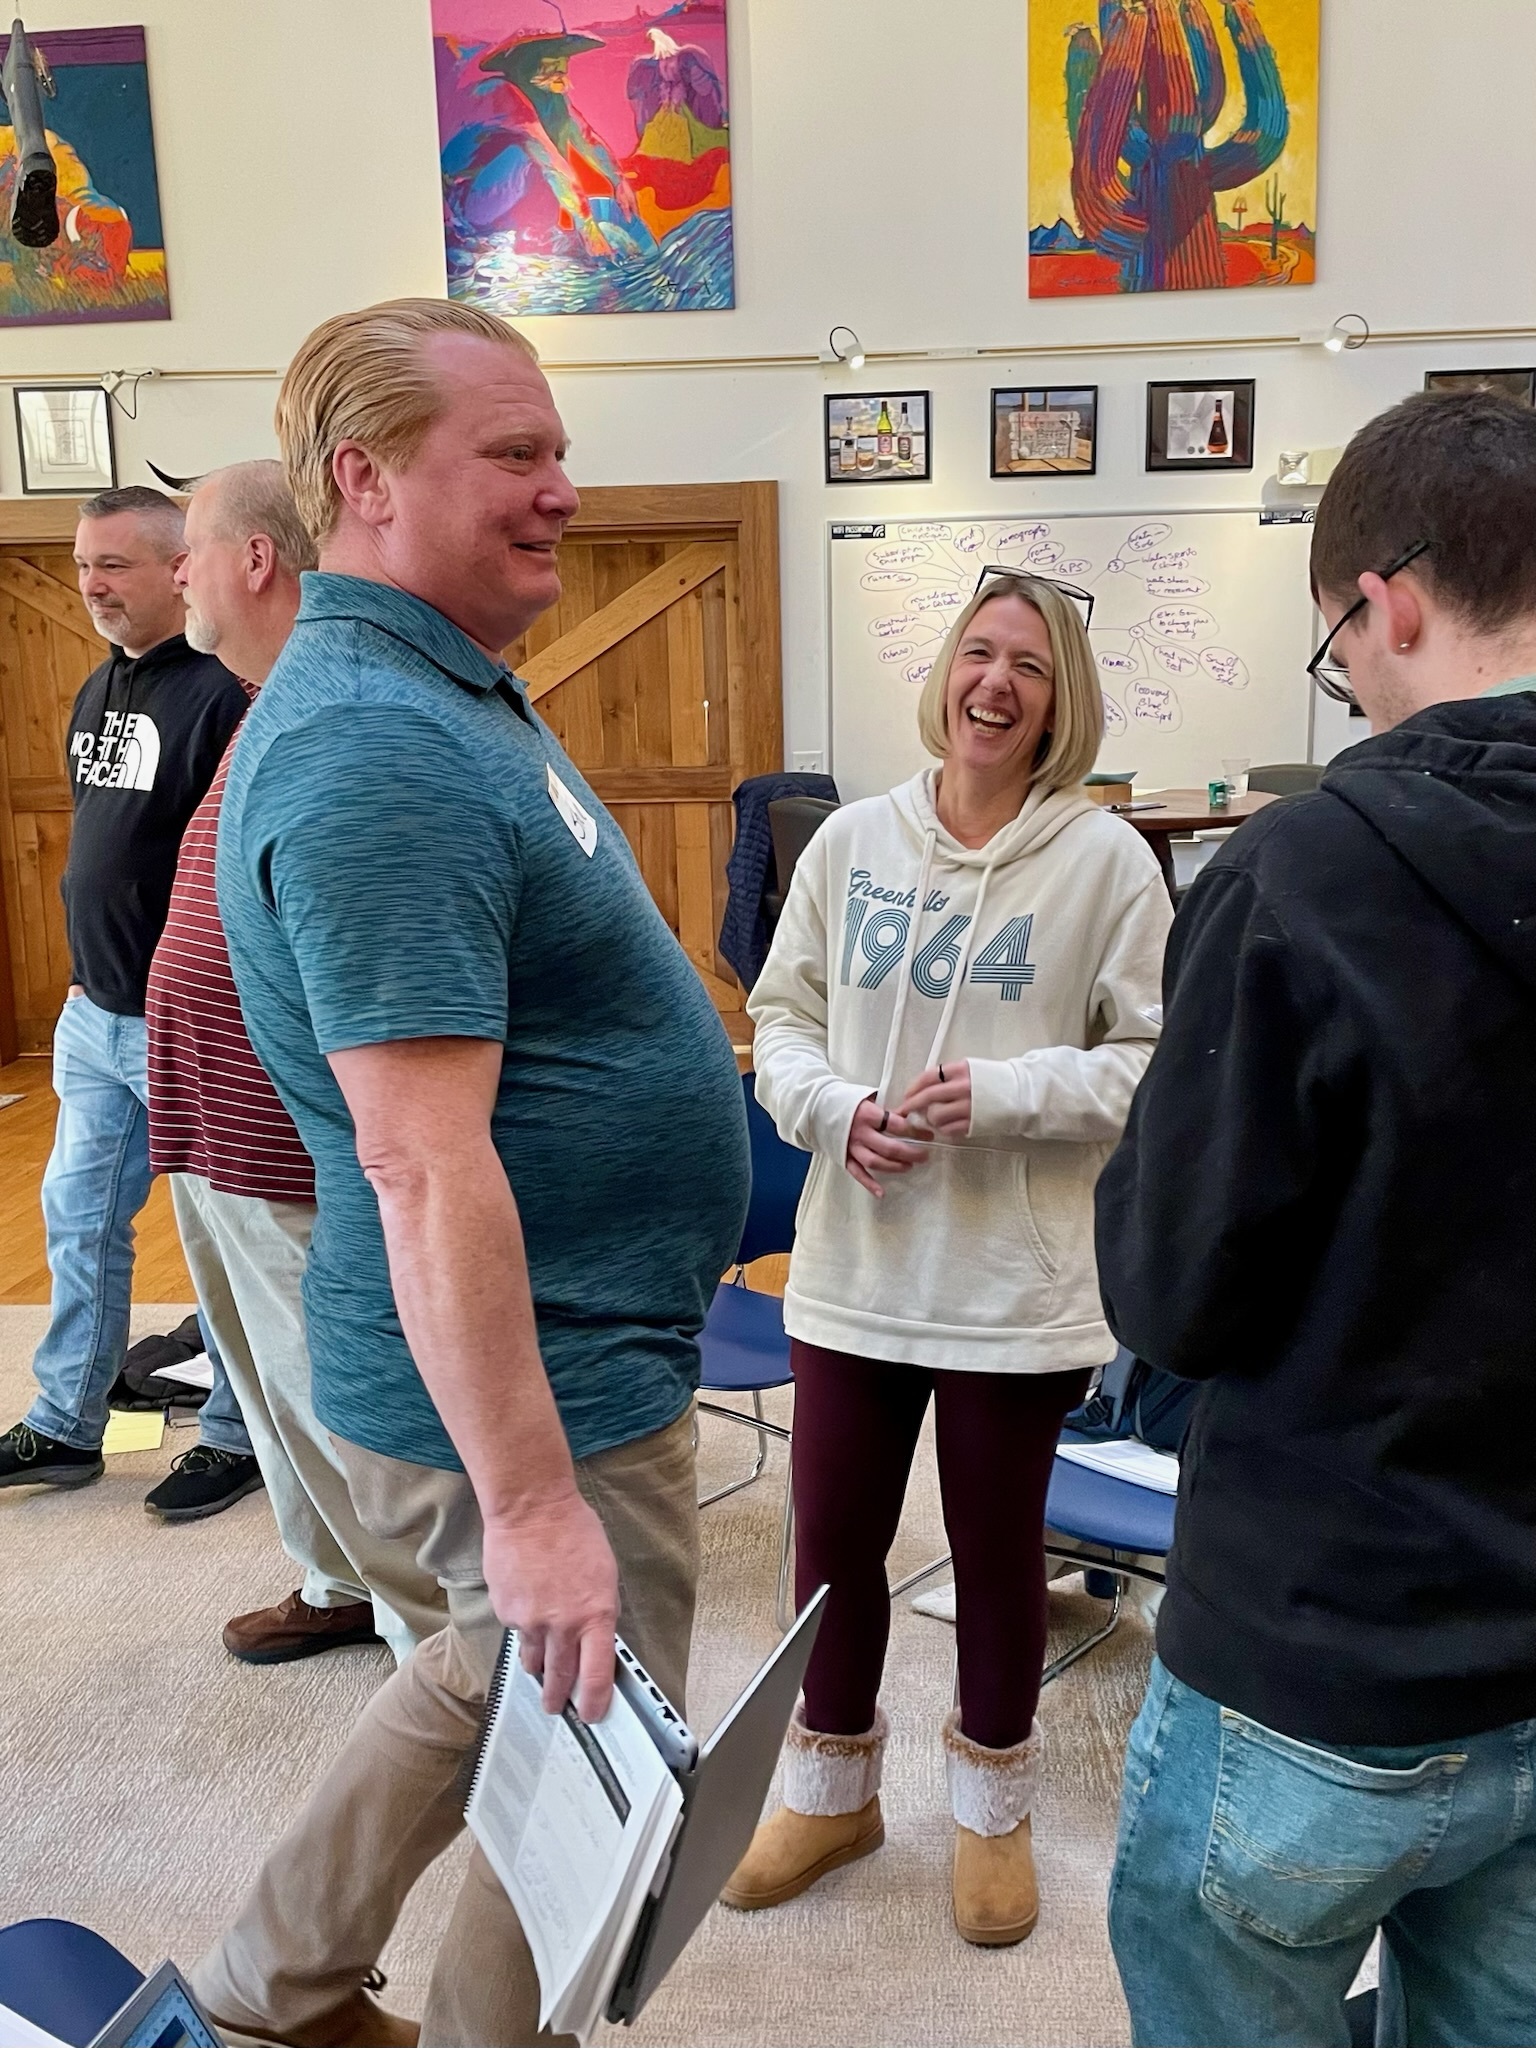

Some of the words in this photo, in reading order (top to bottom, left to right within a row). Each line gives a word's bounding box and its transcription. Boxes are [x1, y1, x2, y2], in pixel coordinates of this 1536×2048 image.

[1058, 563, 1084, 573] GPS
[103, 710, 137, 738] THE
[70, 731, 131, 762] NORTH
[76, 758, 123, 788] FACE
[848, 867, 951, 913] Greenhlls
[840, 897, 1036, 1002] 1964
